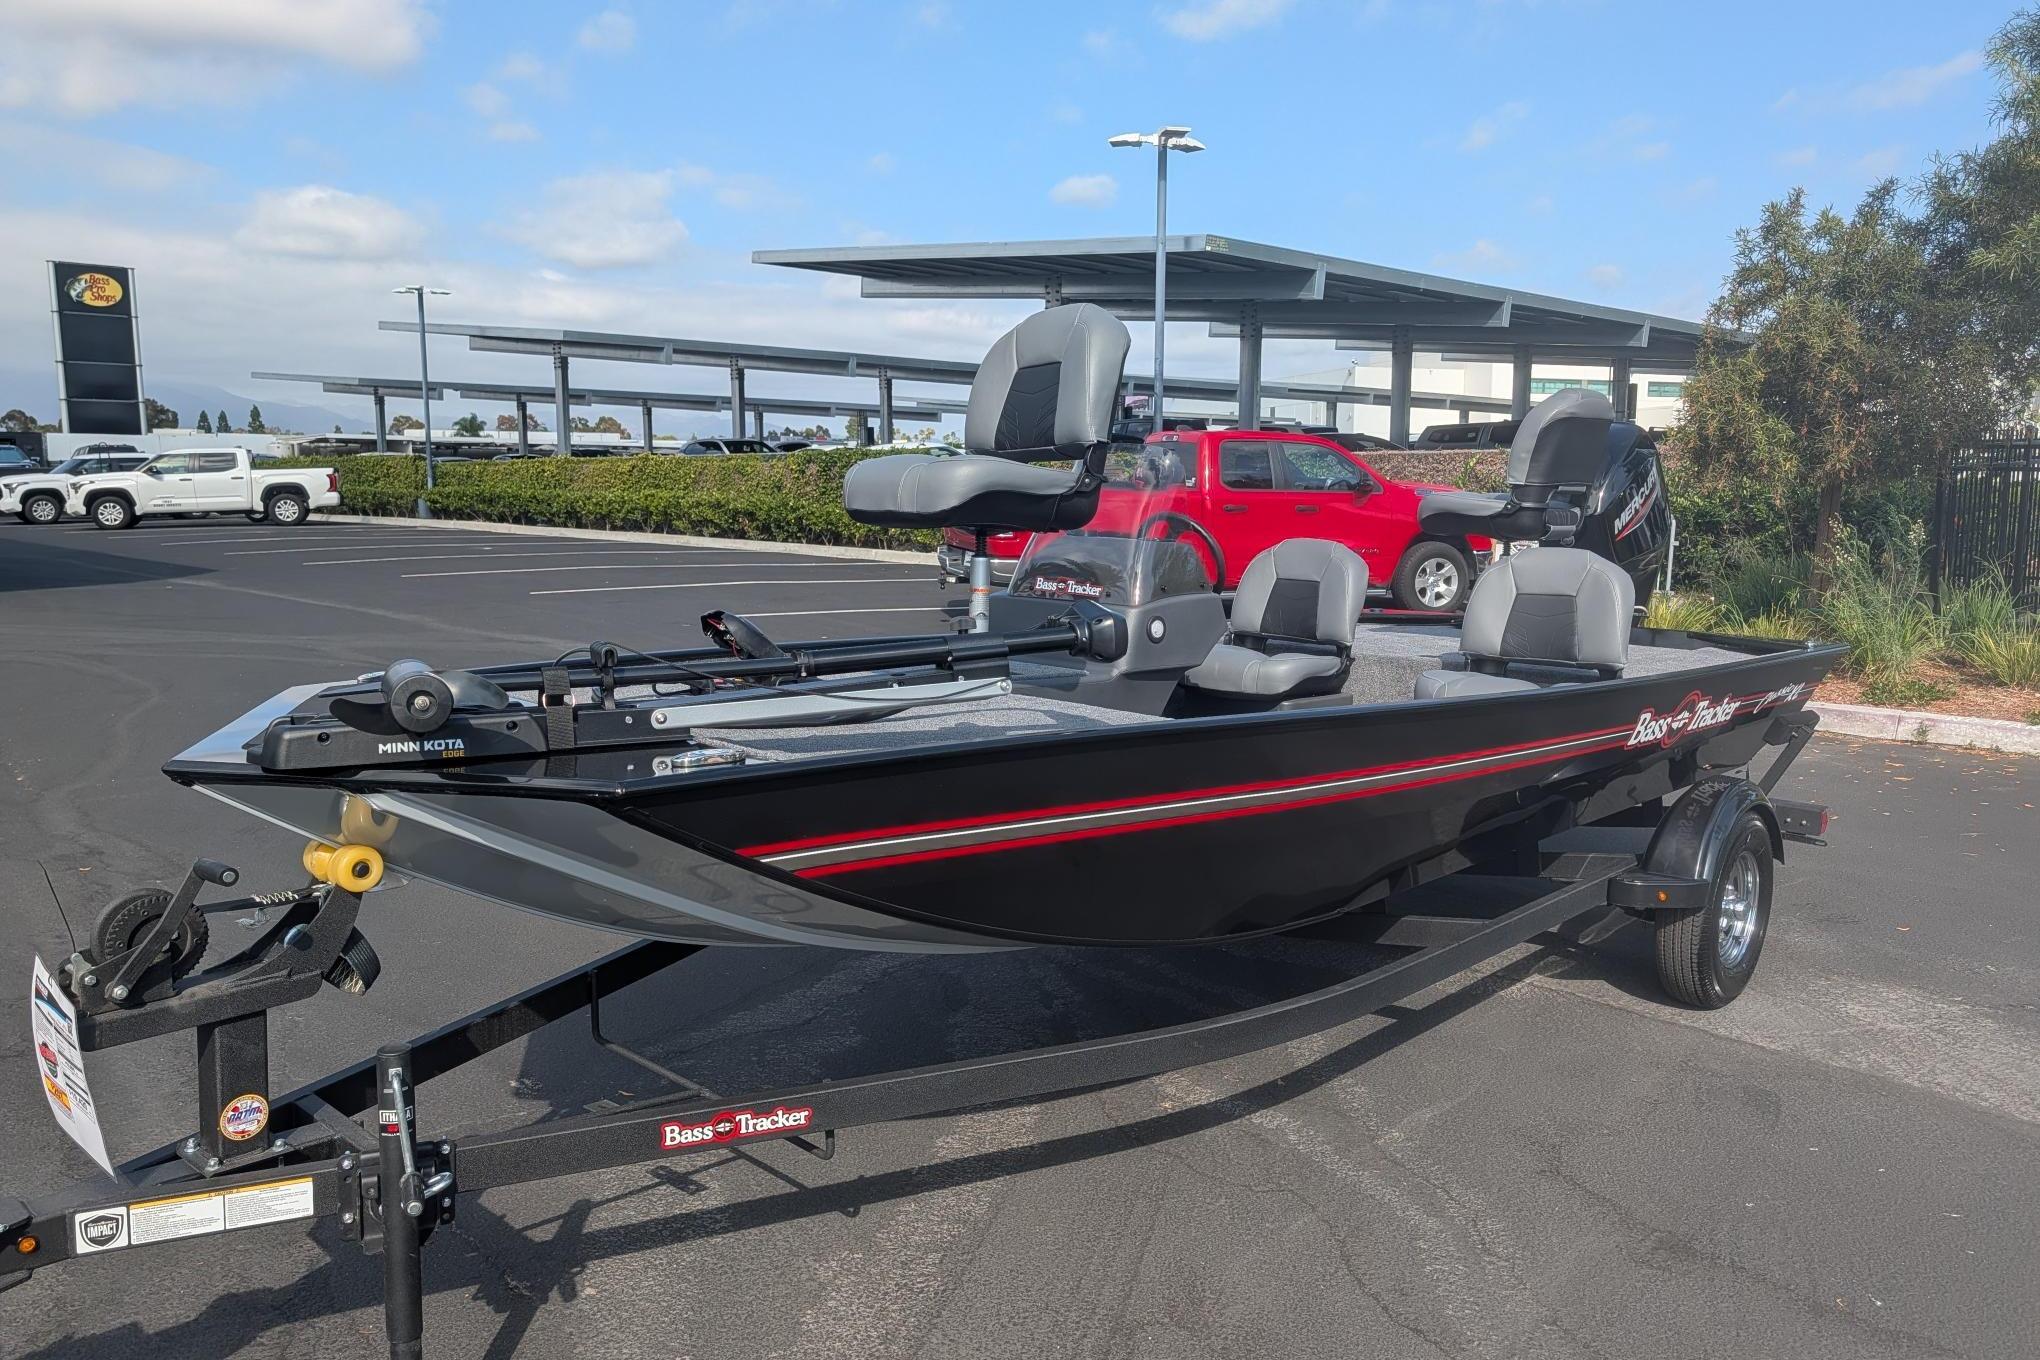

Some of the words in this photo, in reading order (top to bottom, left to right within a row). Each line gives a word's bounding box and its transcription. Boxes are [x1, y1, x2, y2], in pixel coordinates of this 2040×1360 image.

[89, 274, 110, 285] Bass
[90, 283, 106, 293] Pro
[90, 291, 117, 304] Shops
[1035, 577, 1057, 591] Bass
[1067, 580, 1102, 596] Tracker
[1627, 712, 1672, 746] Bass
[1686, 697, 1741, 731] Tracker
[378, 741, 420, 754] MINN
[424, 738, 465, 751] KOTA
[664, 1125, 713, 1146] Bass
[735, 1109, 809, 1134] Tracker
[87, 1222, 117, 1239] IMPACT
